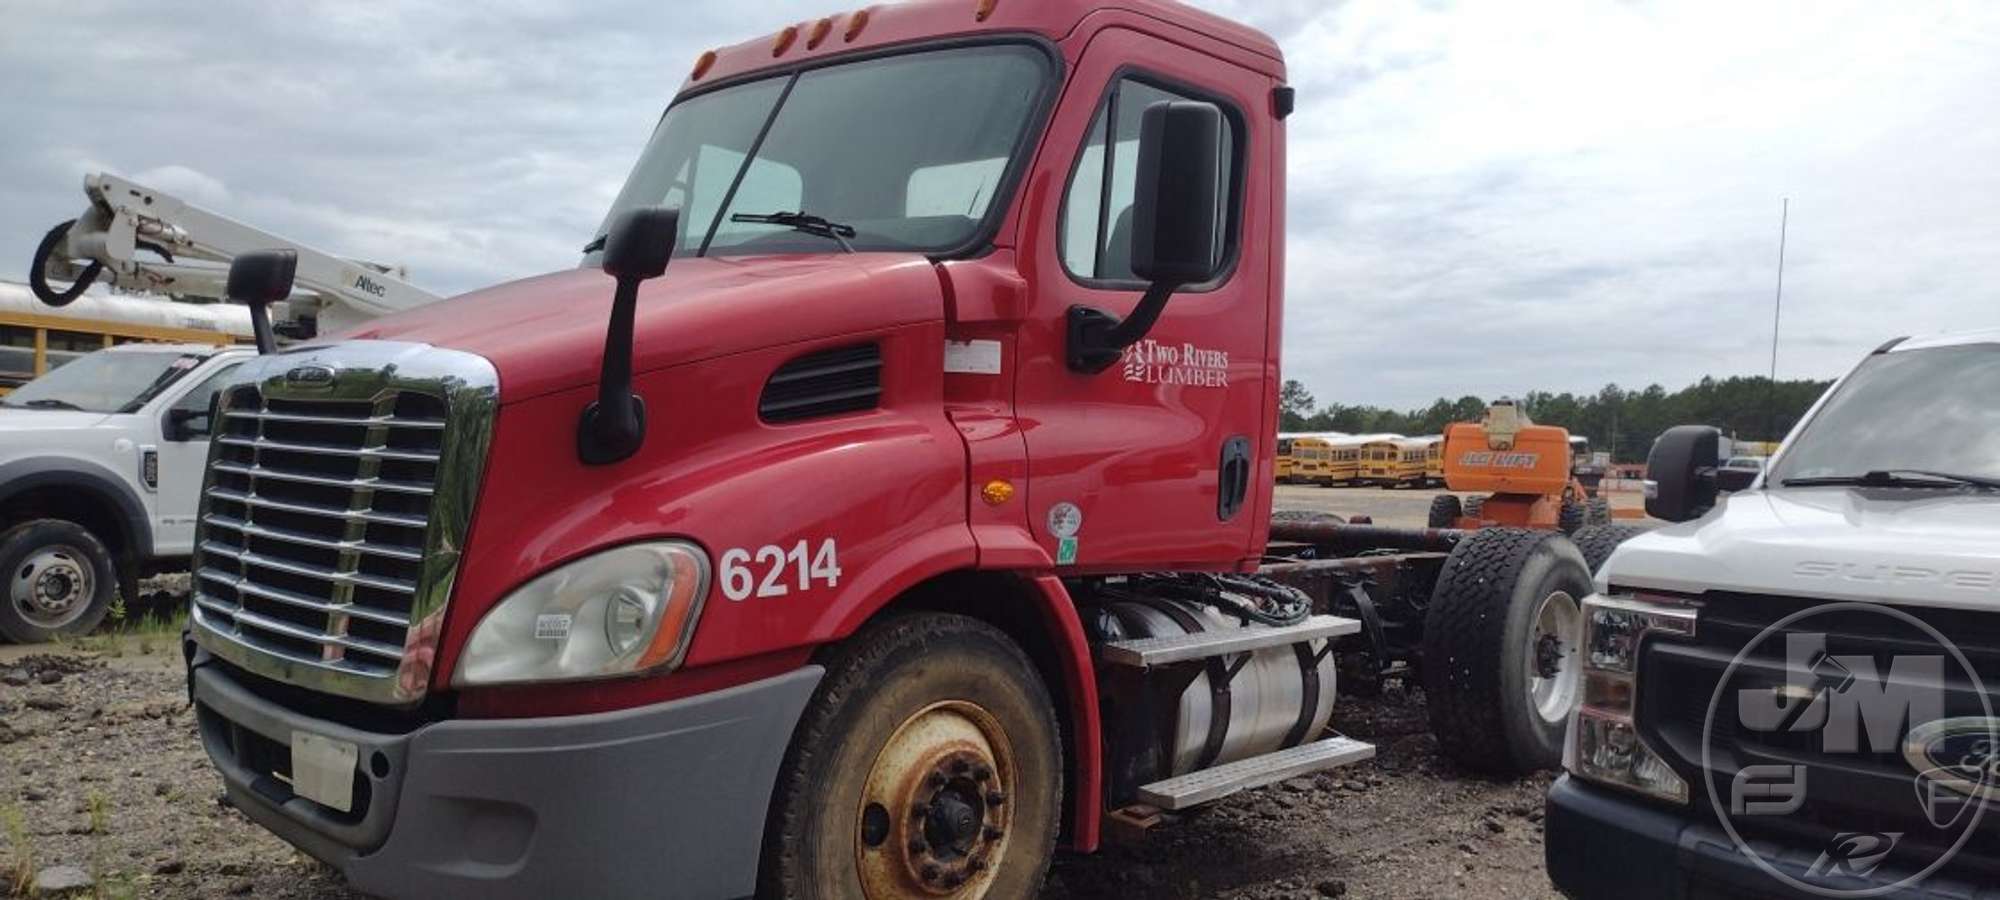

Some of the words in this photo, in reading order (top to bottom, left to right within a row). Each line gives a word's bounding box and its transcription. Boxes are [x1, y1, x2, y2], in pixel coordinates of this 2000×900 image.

[355, 275, 386, 298] Altec
[1145, 339, 1178, 365] TWO
[1183, 343, 1228, 369] RIVERS
[1147, 365, 1228, 387] LUMBER
[720, 538, 842, 601] 6214
[1793, 560, 2000, 591] SUPE
